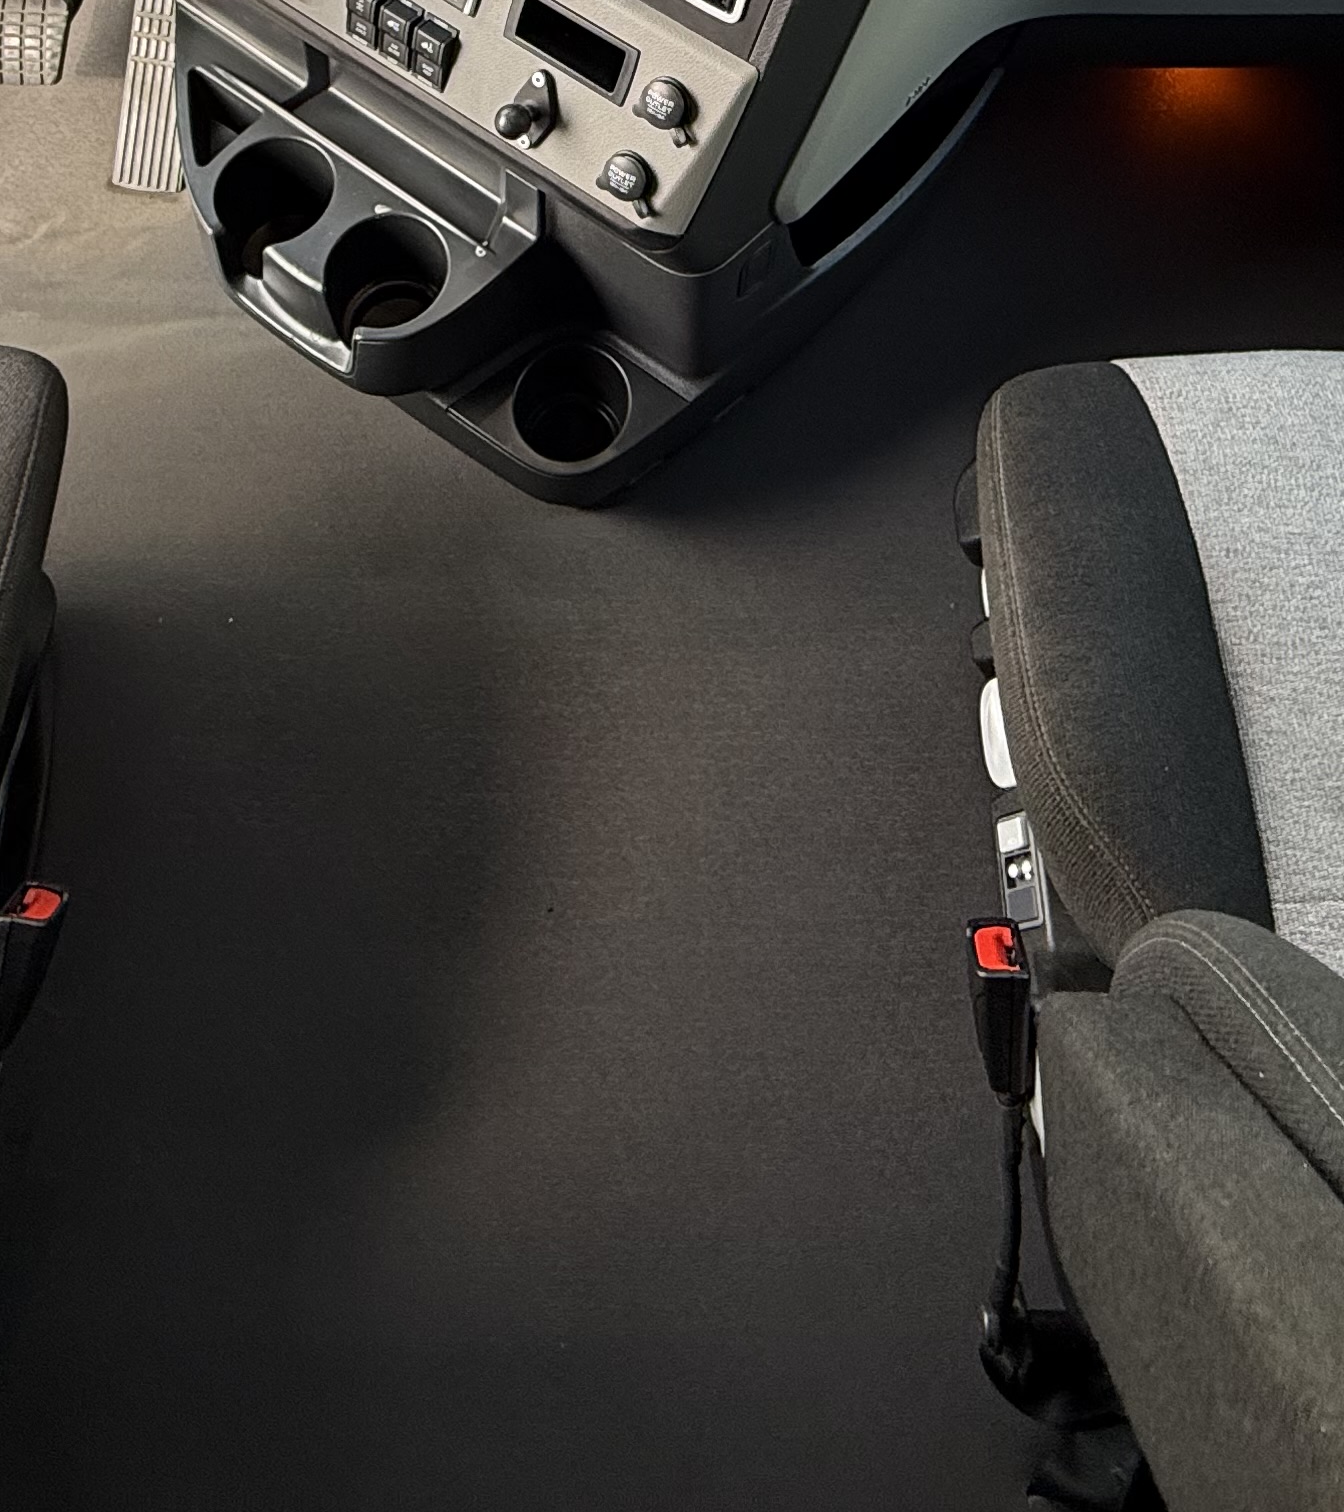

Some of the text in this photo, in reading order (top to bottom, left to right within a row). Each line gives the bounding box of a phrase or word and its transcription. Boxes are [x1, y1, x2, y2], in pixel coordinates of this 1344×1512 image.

[645, 95, 673, 115] OUTLET
[647, 89, 675, 108] POWER
[607, 170, 635, 189] OUTLET
[609, 163, 637, 183] POWER
